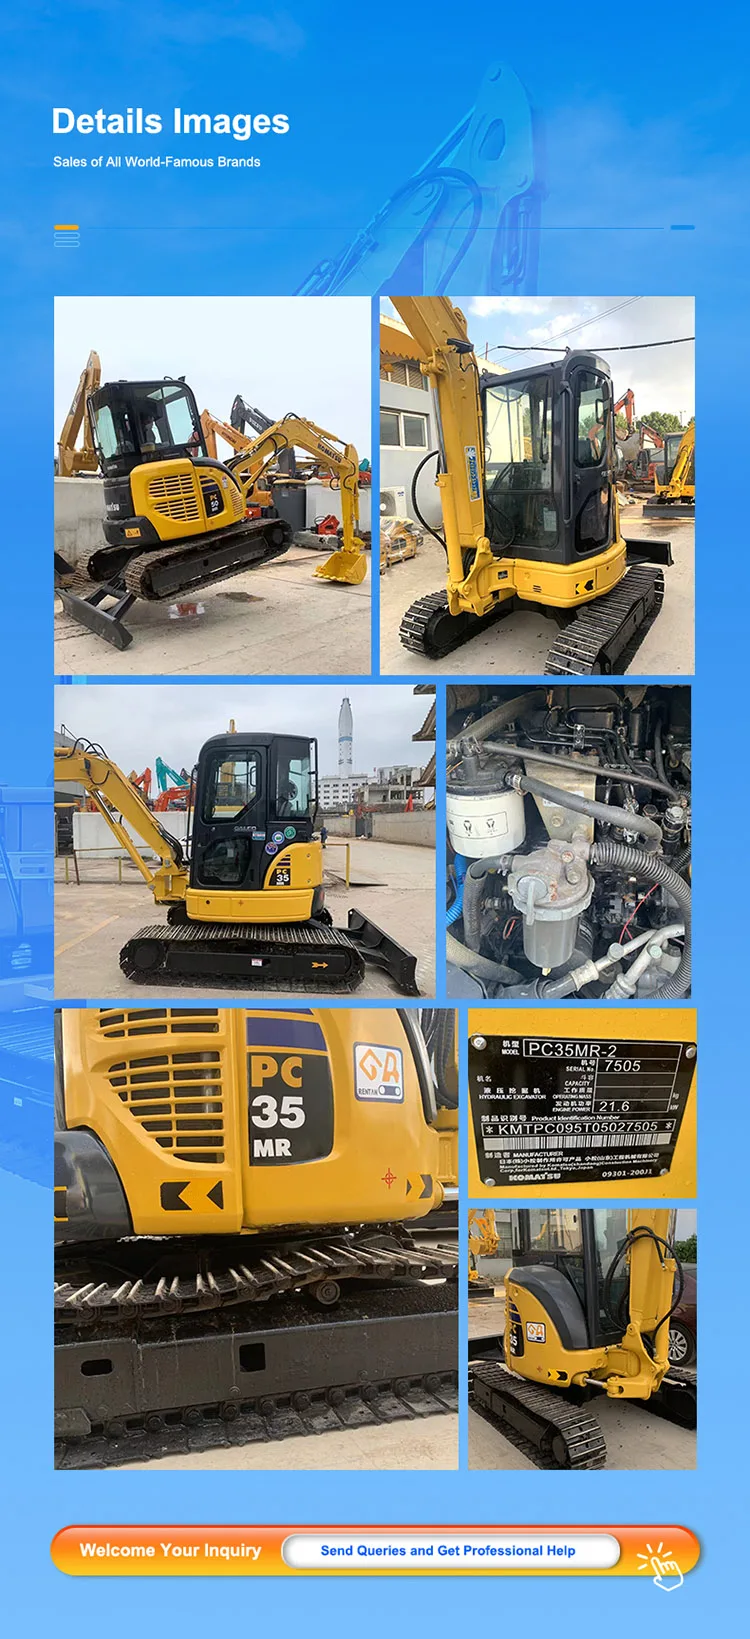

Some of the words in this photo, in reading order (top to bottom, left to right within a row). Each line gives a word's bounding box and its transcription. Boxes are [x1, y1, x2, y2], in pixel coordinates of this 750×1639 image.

[317, 443, 342, 463] KOMATSU
[276, 874, 289, 882] 35
[529, 1042, 617, 1058] PC35MR-2
[250, 1055, 303, 1088] PC
[604, 1060, 641, 1072] 7505
[251, 1095, 306, 1129] 35
[599, 1101, 630, 1112] 21.6
[498, 1121, 658, 1135] KMTPC095T05027505
[253, 1138, 292, 1158] MR
[509, 1172, 561, 1181] KOMATSU
